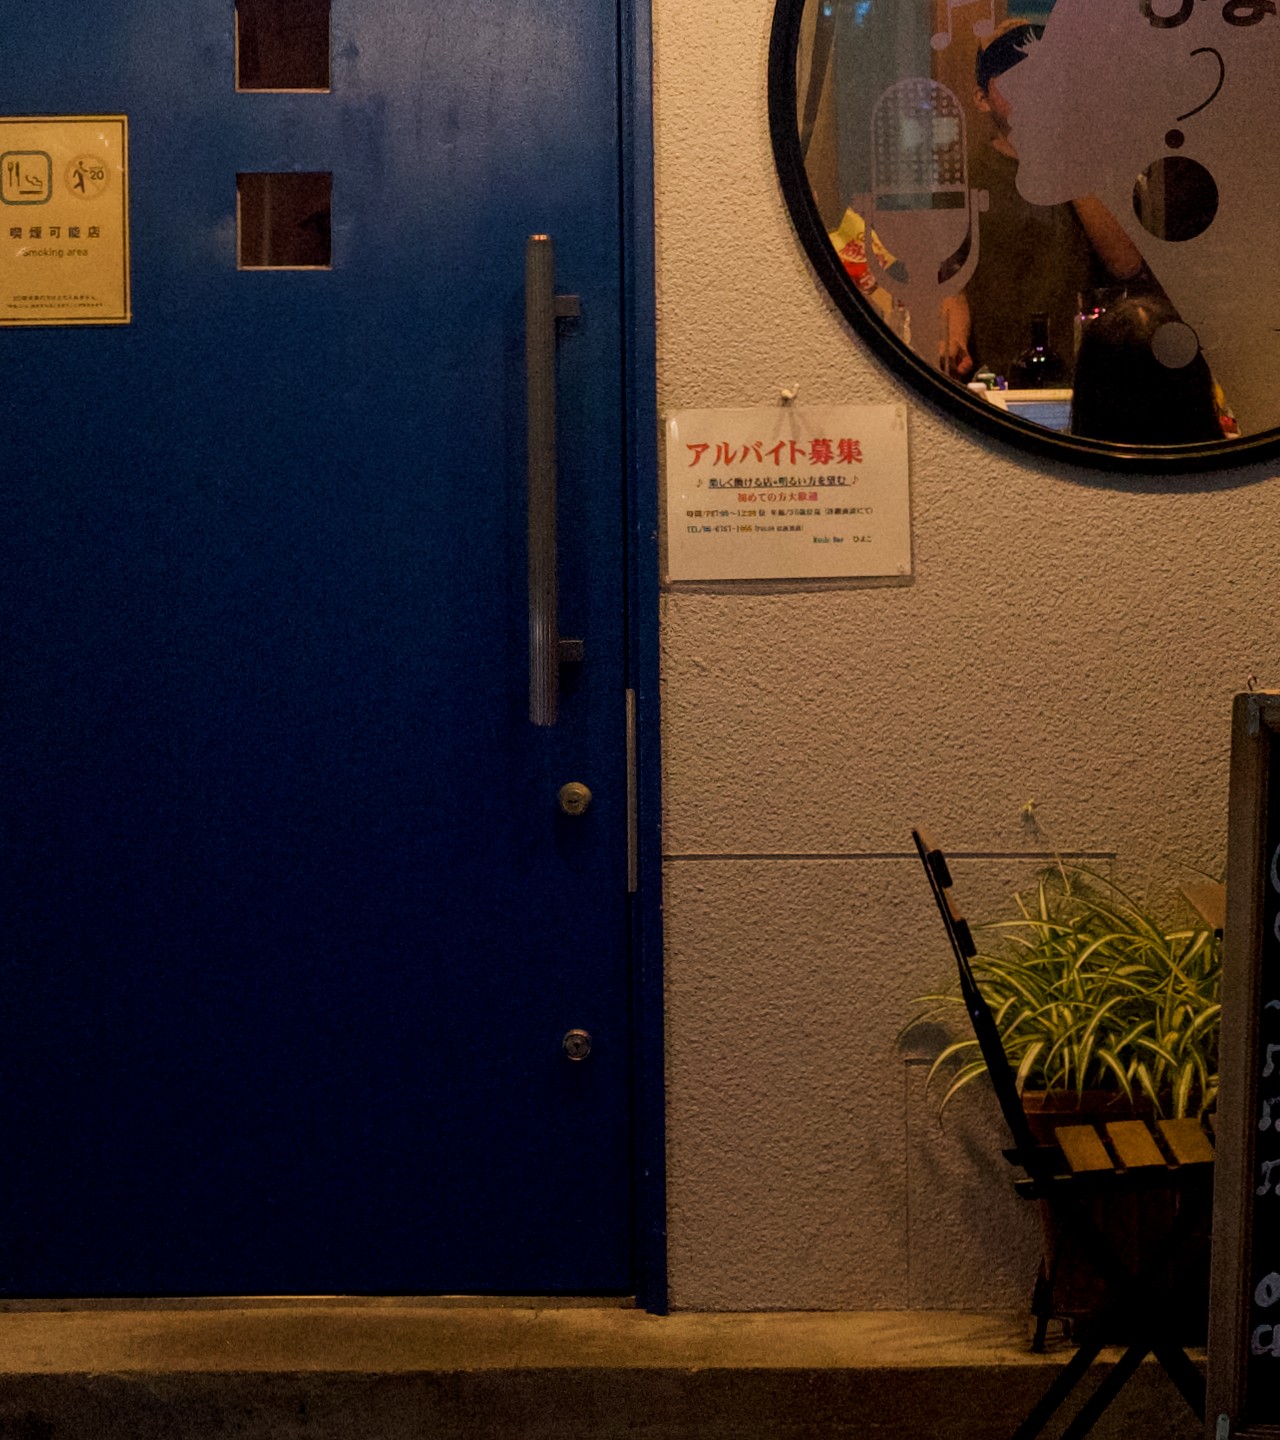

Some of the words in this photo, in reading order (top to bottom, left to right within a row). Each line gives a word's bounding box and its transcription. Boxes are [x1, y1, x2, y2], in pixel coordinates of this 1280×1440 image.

[89, 169, 105, 181] 20
[66, 248, 89, 257] area
[685, 437, 864, 468] アルバイト募集
